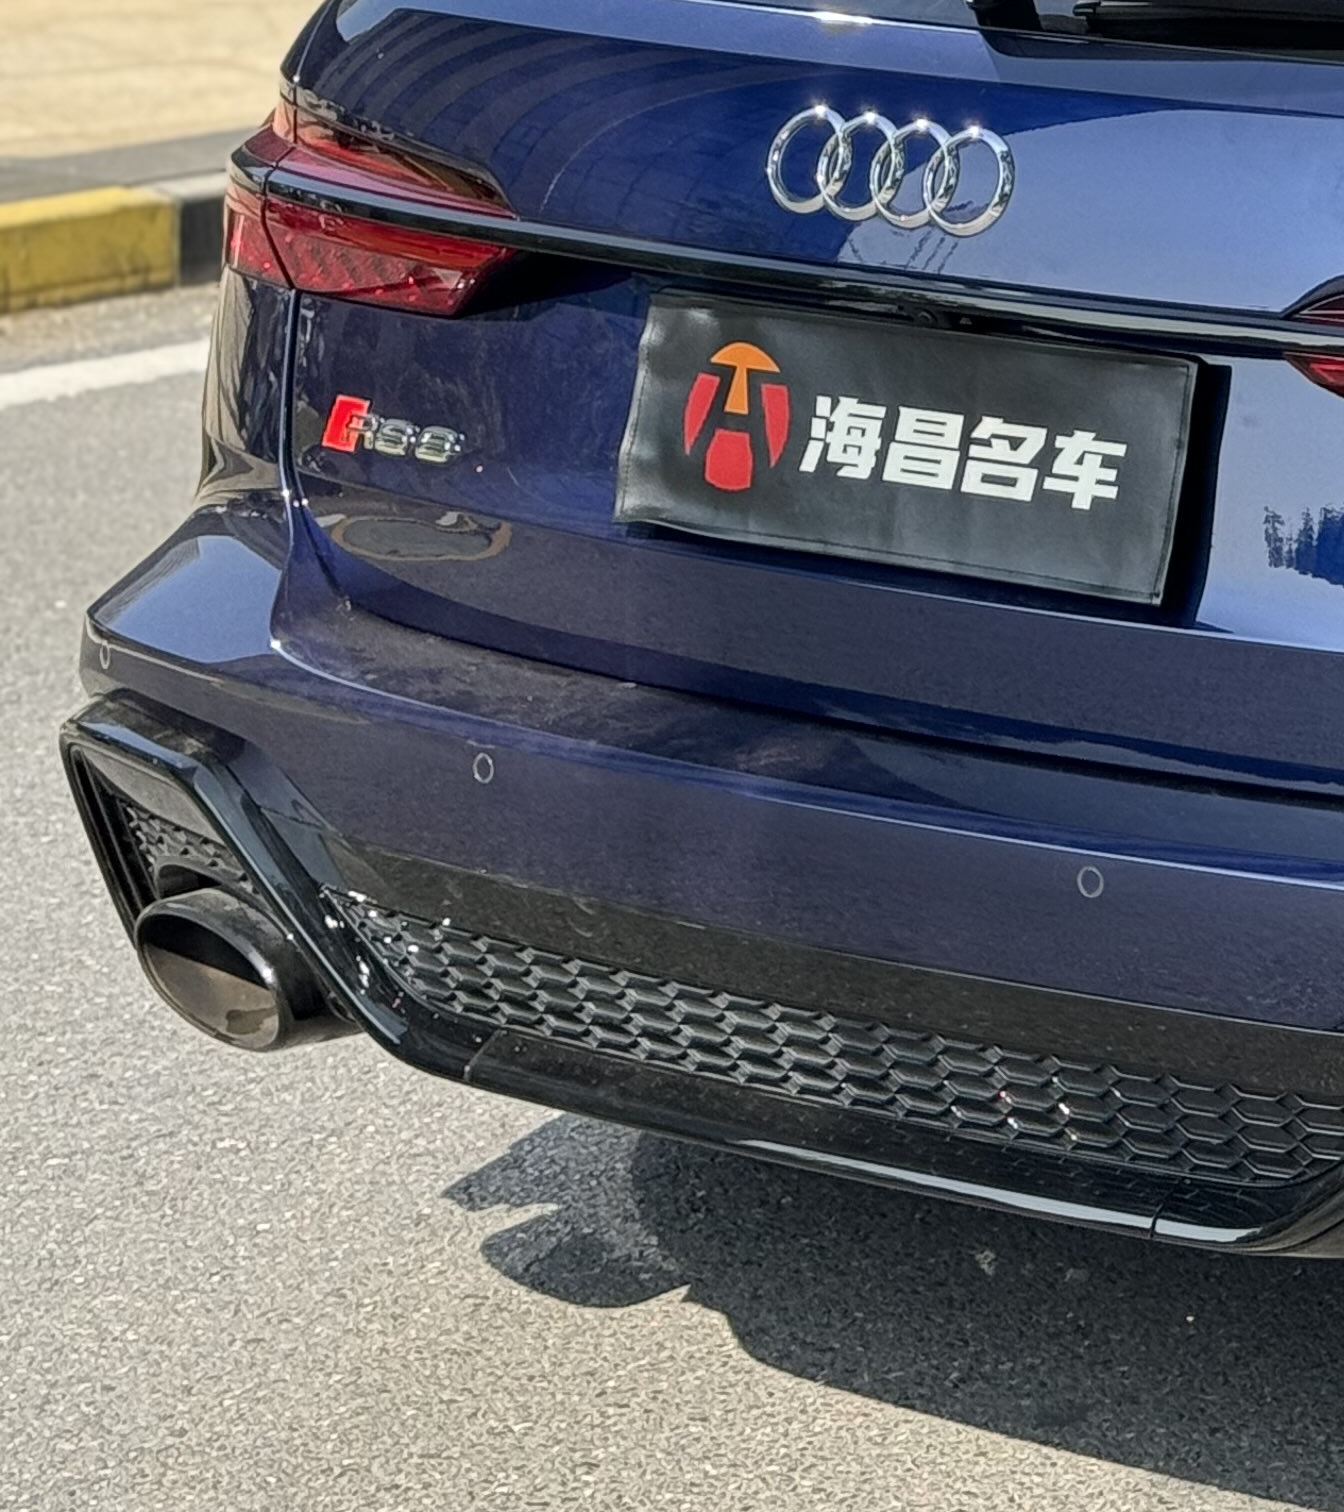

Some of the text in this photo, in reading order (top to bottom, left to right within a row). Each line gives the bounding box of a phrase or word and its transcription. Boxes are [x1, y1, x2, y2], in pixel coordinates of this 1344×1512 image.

[322, 394, 464, 464] RS6
[800, 394, 1127, 510] 海昌名车
